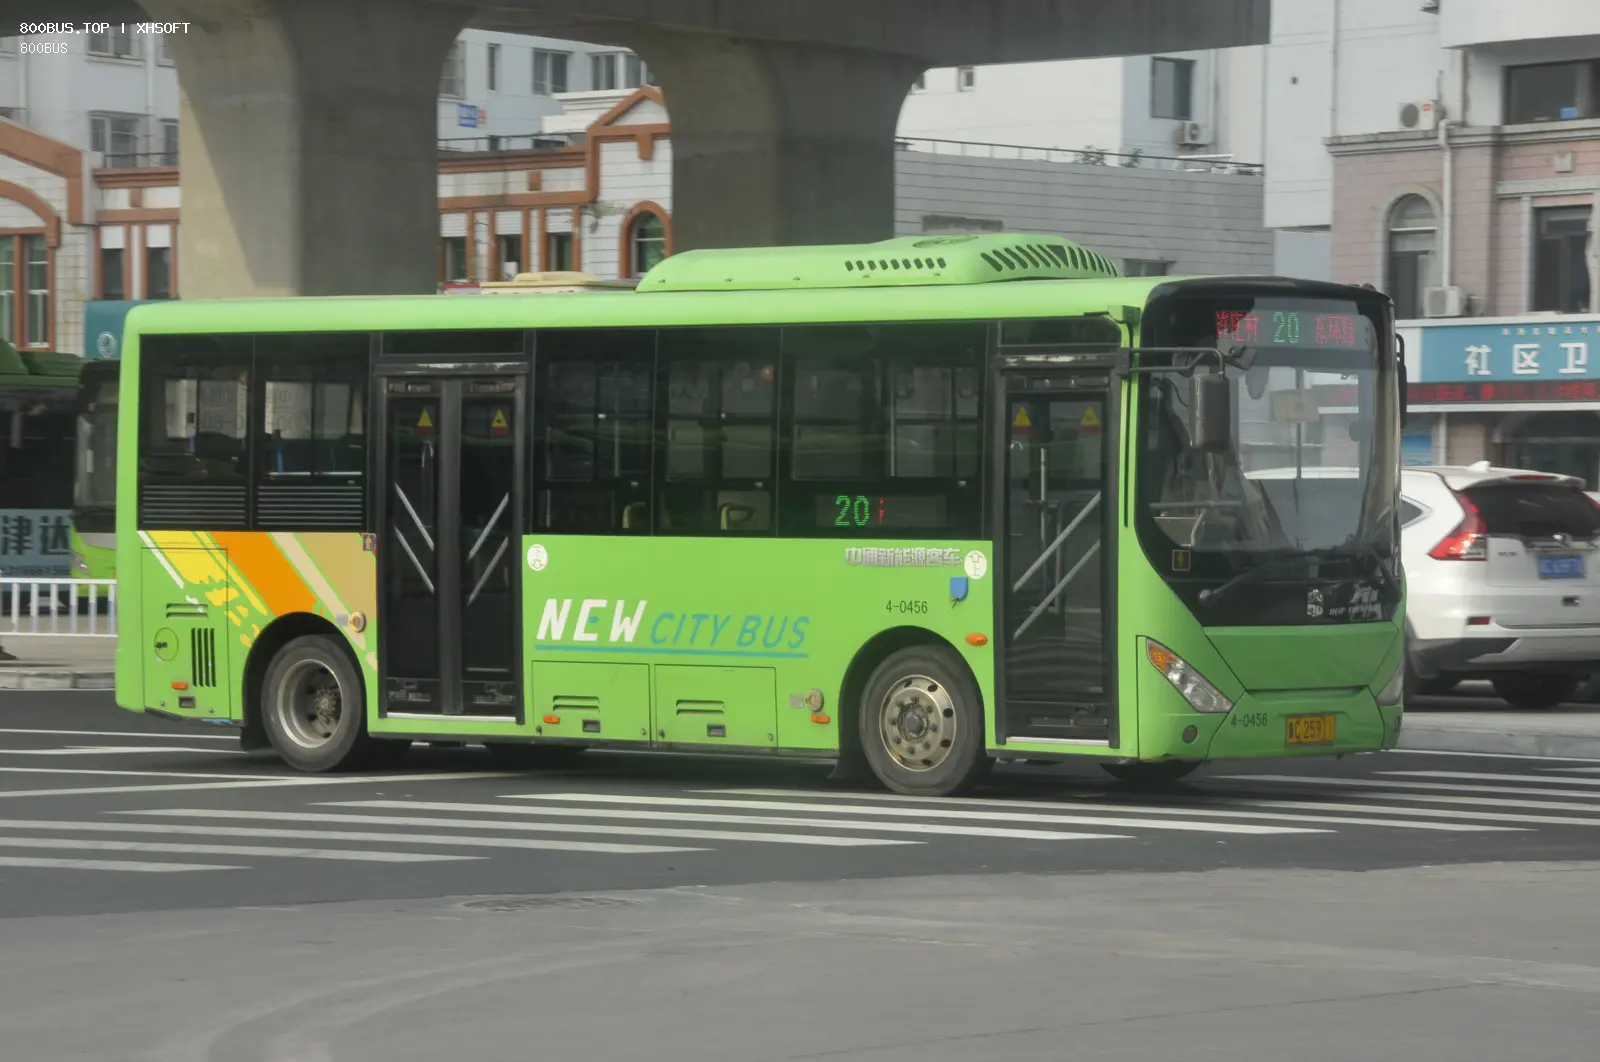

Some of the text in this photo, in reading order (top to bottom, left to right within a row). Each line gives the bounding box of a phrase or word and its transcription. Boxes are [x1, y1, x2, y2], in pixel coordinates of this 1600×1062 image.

[1273, 312, 1299, 343] 20
[1464, 343, 1588, 376] 社区卫
[835, 496, 870, 526] 20
[885, 600, 928, 614] 4-0456
[536, 598, 810, 649] NEW CITY BUS
[1230, 713, 1268, 728] 4-0456
